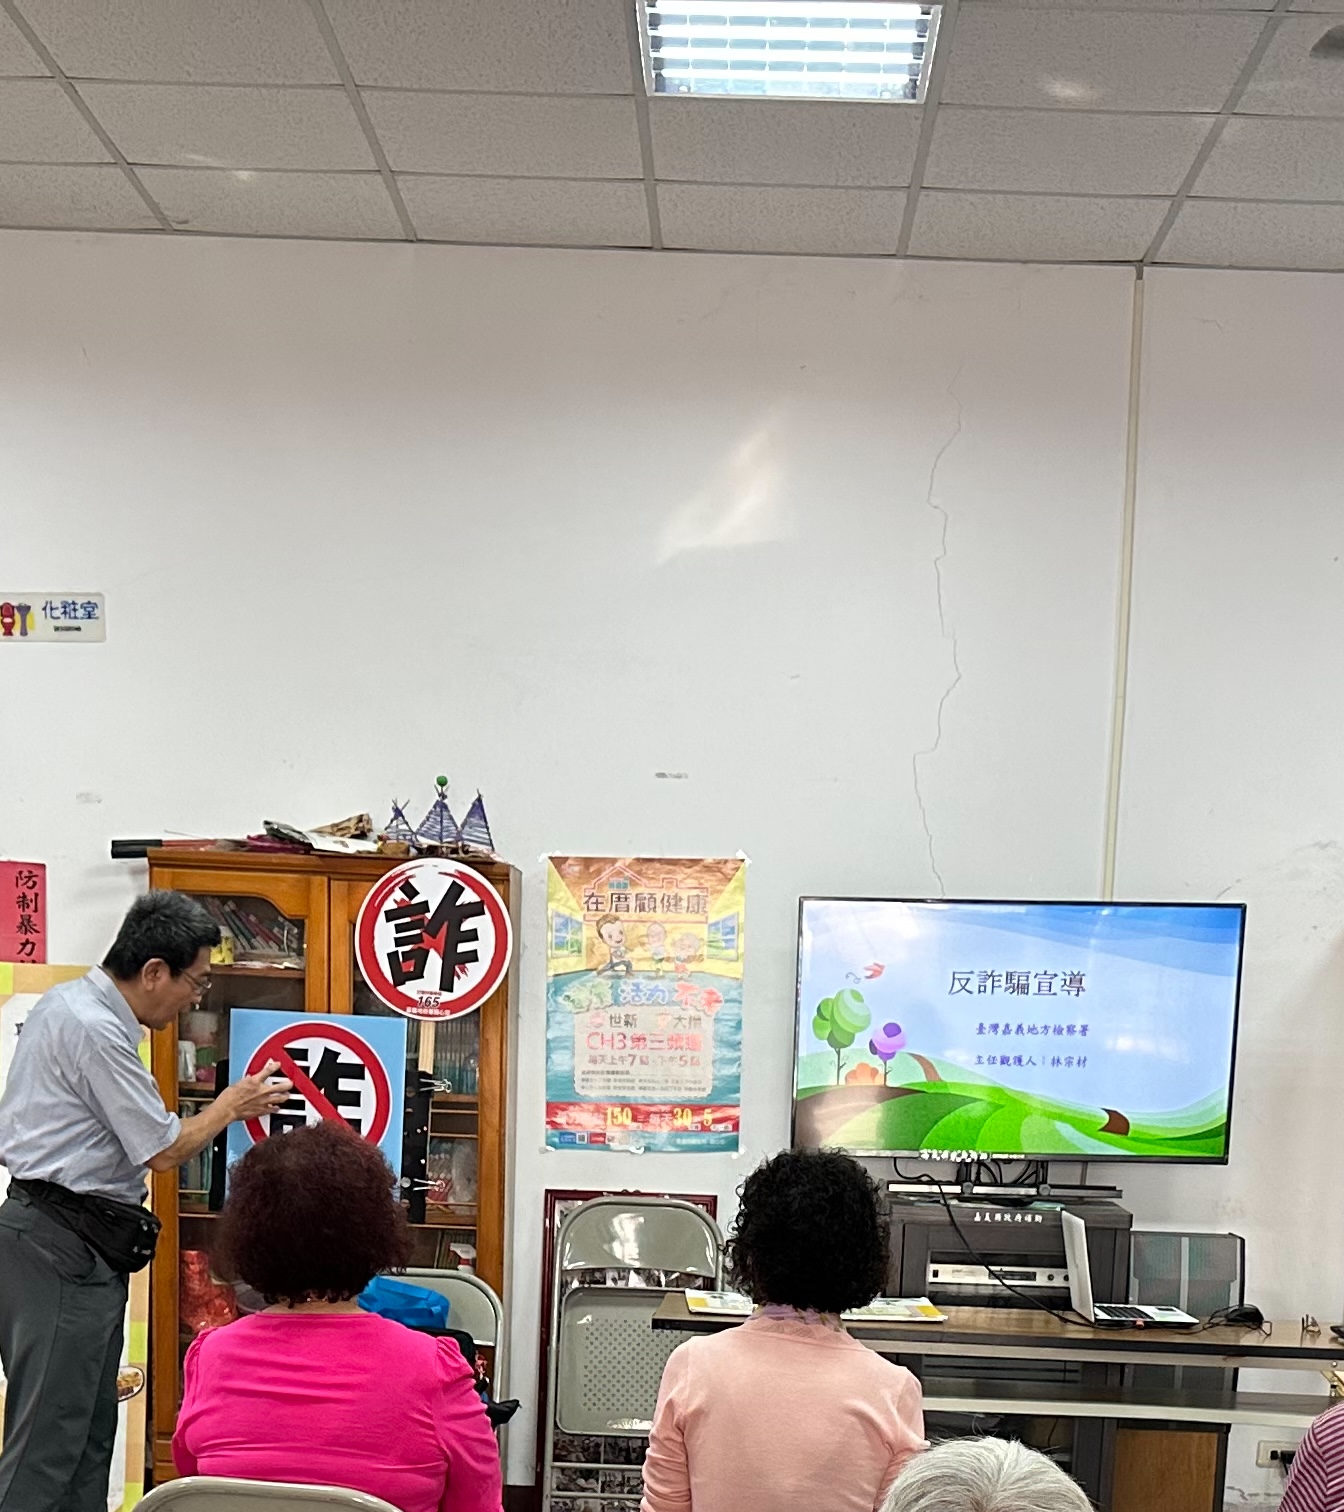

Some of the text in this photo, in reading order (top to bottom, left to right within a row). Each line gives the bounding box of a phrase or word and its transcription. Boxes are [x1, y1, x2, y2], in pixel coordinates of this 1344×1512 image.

[41, 600, 99, 620] 化粧室
[583, 891, 707, 914] 在厝顧健康
[15, 870, 41, 963] 防制暴力
[384, 880, 485, 993] 詐
[948, 970, 1086, 997] 反詐騙宣導
[418, 996, 440, 1007] 165
